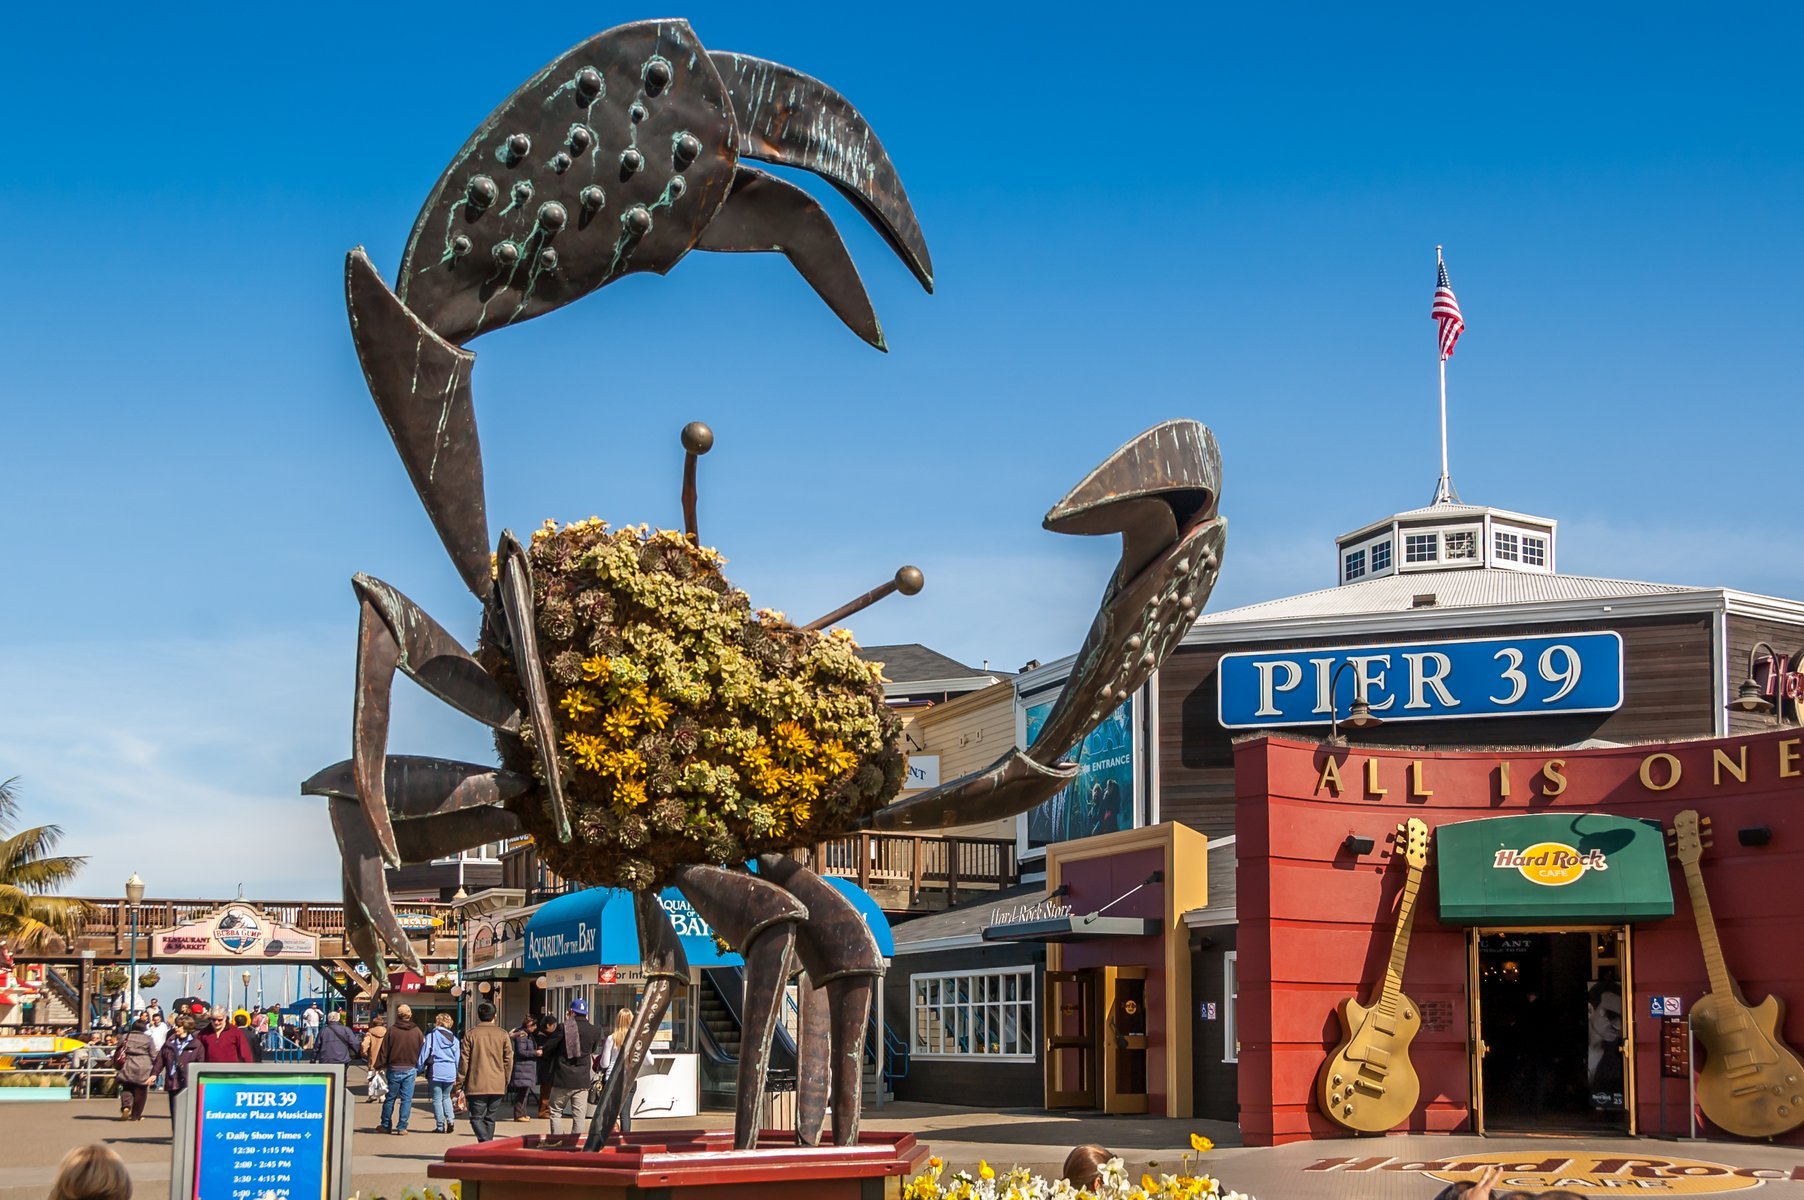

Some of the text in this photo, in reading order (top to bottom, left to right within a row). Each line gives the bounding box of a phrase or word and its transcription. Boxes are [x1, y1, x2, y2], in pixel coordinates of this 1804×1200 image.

[1252, 644, 1582, 716] PIER 39
[1092, 753, 1131, 772] ENTRANCE
[1319, 738, 1801, 796] ALL IS ONE
[1495, 850, 1605, 869] Hard Rock
[1538, 869, 1569, 877] CAFE
[1019, 902, 1042, 923] Rock
[1044, 900, 1072, 919] Store
[670, 914, 710, 937] BAY
[216, 929, 262, 937] BUBBA GUMP
[162, 936, 211, 944] RESTAURANT
[528, 931, 564, 966] AQUARIUM
[578, 922, 596, 952] BAY
[175, 943, 207, 951] MARKET
[235, 1092, 298, 1107] PIER 39
[205, 1110, 323, 1120] Entrance Plaza Musicians
[225, 1131, 302, 1141] Daily Show Times
[232, 1146, 256, 1154] 12:30
[262, 1146, 280, 1154] 1:15
[281, 1146, 295, 1154] PM
[234, 1161, 252, 1169] 2:00
[278, 1160, 292, 1168] PM
[1302, 1156, 1804, 1180] Hard Roc
[233, 1175, 252, 1183] 3:30
[277, 1174, 291, 1182] PM
[1502, 1177, 1669, 1189] CAFE
[276, 1189, 290, 1197] PM
